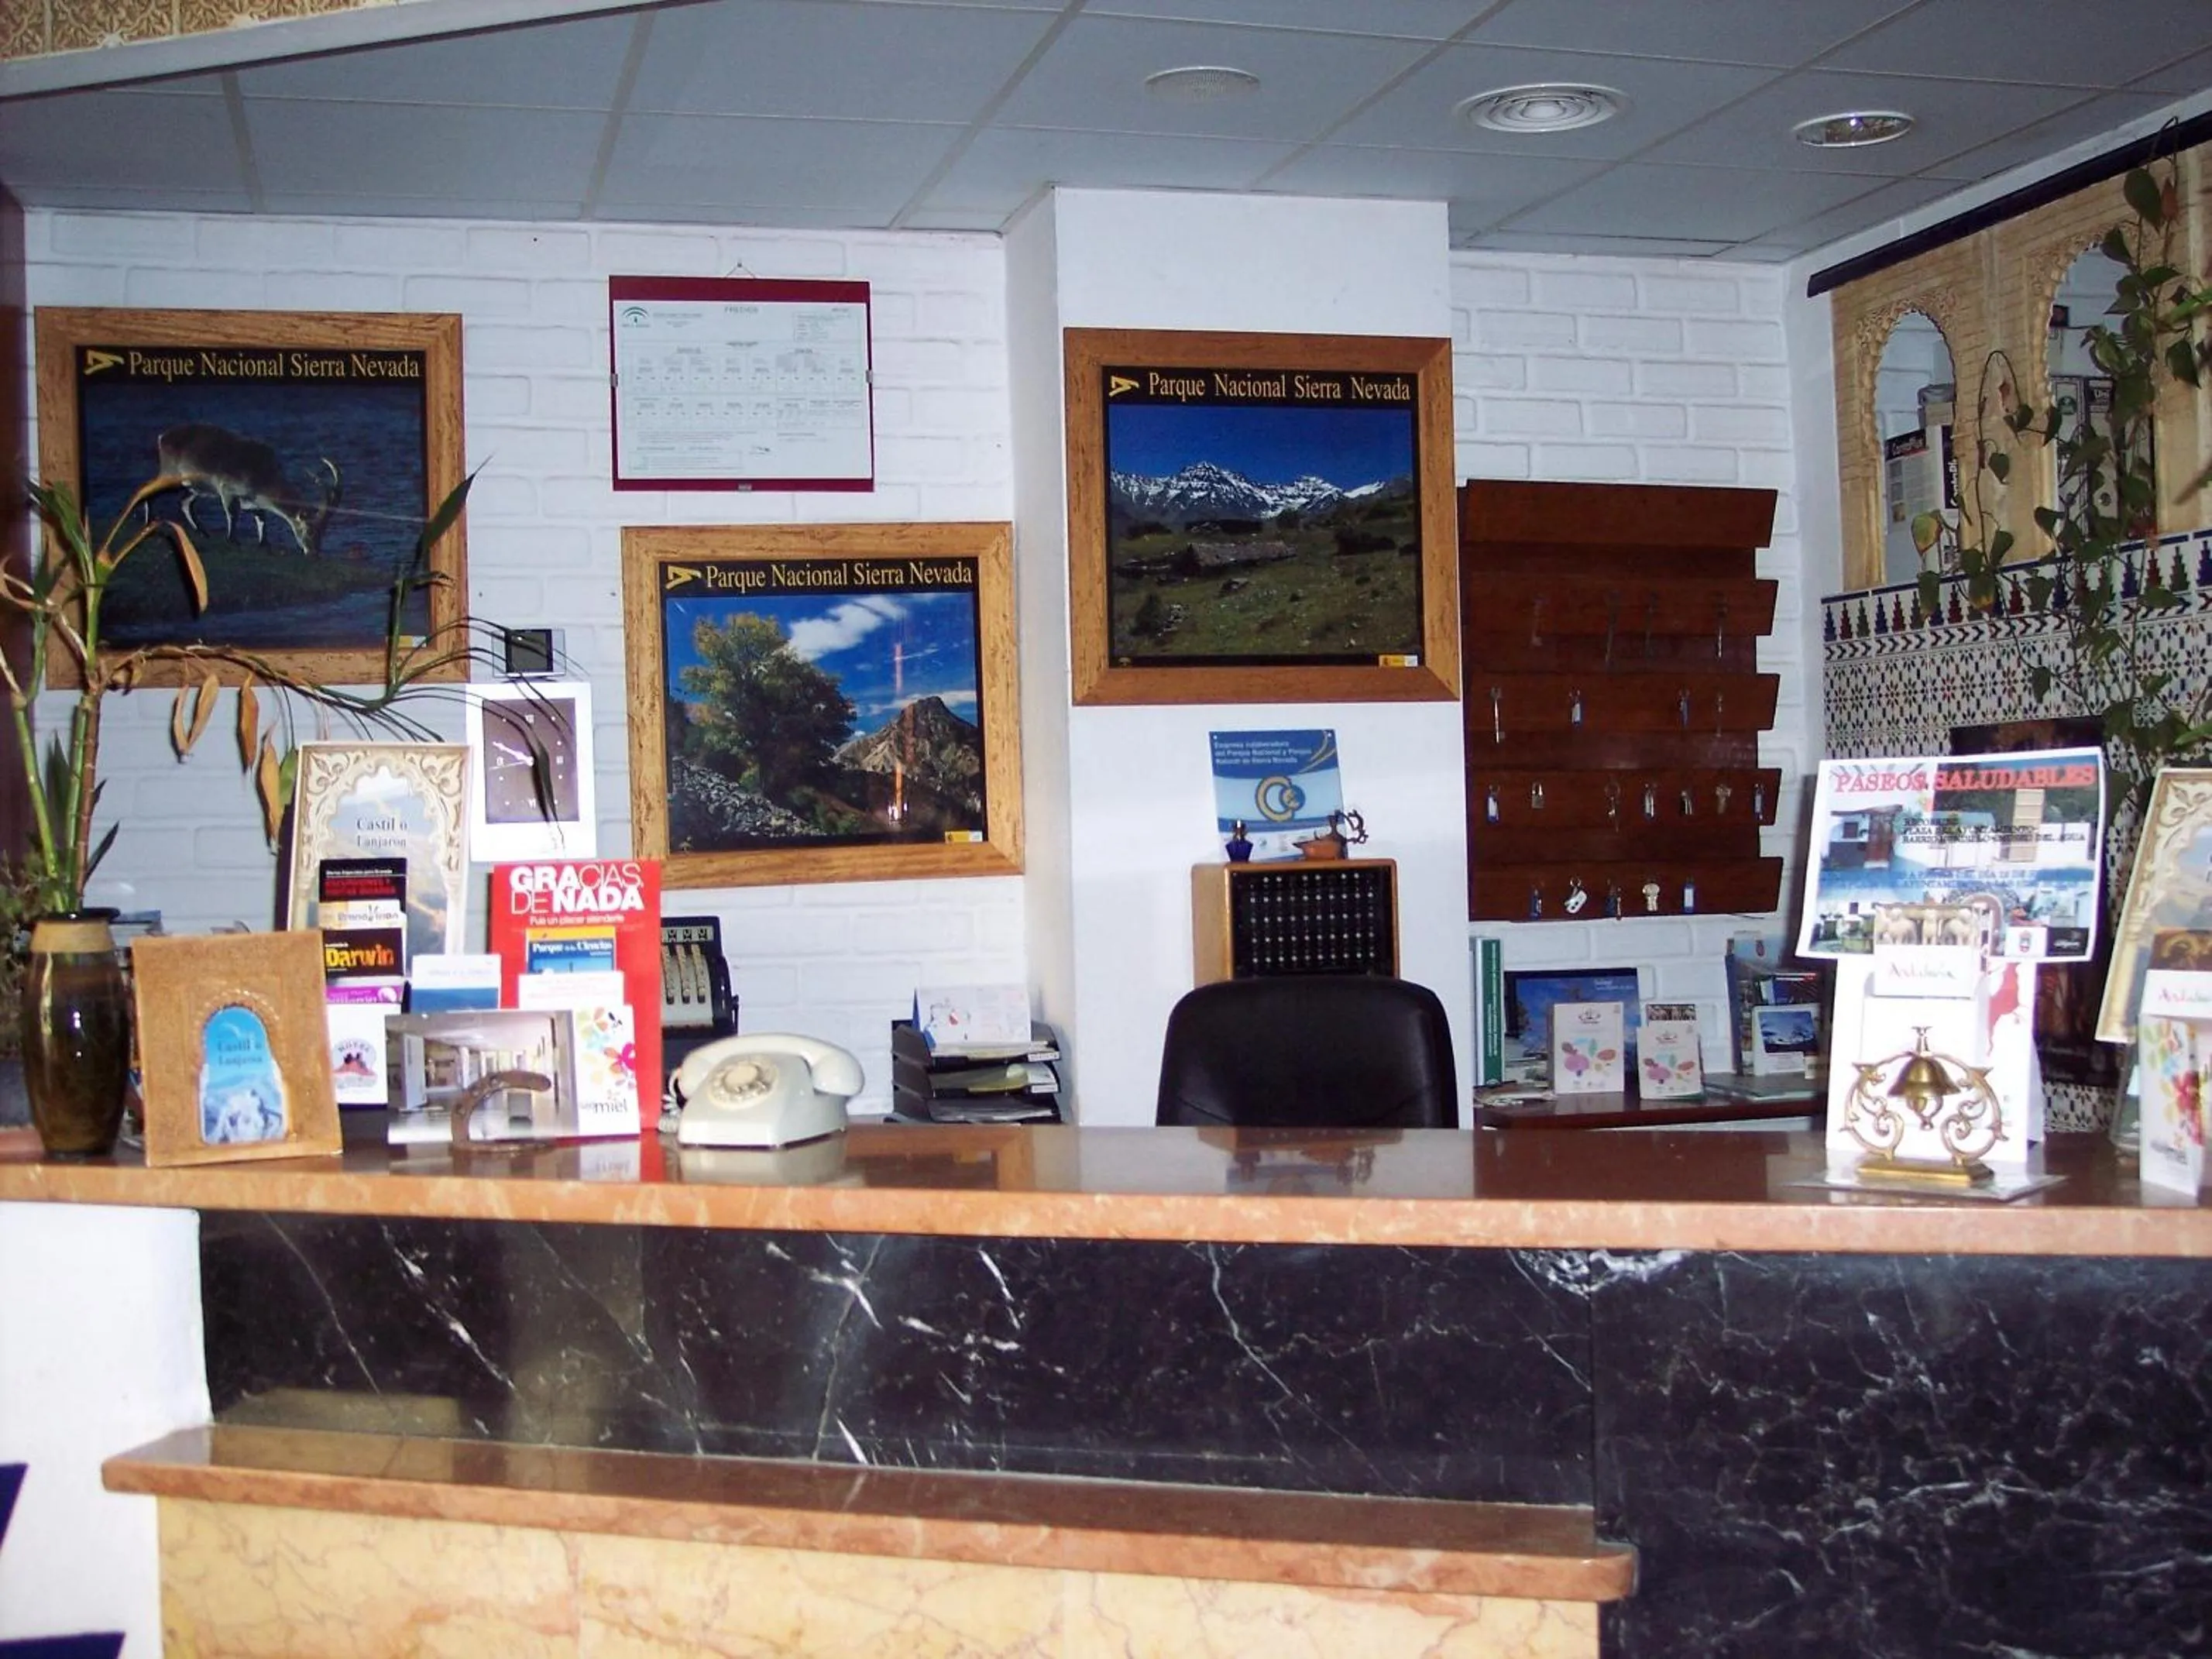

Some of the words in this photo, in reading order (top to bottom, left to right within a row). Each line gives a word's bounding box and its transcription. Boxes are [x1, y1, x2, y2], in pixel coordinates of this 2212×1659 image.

[129, 351, 194, 382] Parque
[201, 352, 283, 377] Nacional
[291, 353, 345, 378] Sierra
[351, 354, 419, 378] Nevada
[1149, 372, 1206, 402] Parque
[1214, 373, 1286, 398] Nacional
[1295, 375, 1341, 399] Sierra
[1352, 376, 1410, 401] Nevada
[706, 565, 764, 593] Parque
[771, 563, 848, 587] Nacional
[854, 563, 904, 586] Sierra
[910, 562, 972, 585] Nevada
[1834, 770, 1929, 792] PASEOS
[1932, 764, 2097, 792] SALUDABLES
[356, 817, 407, 832] Castilo
[511, 890, 548, 915] DE
[551, 884, 644, 912] NADA
[325, 943, 395, 967] Darwin
